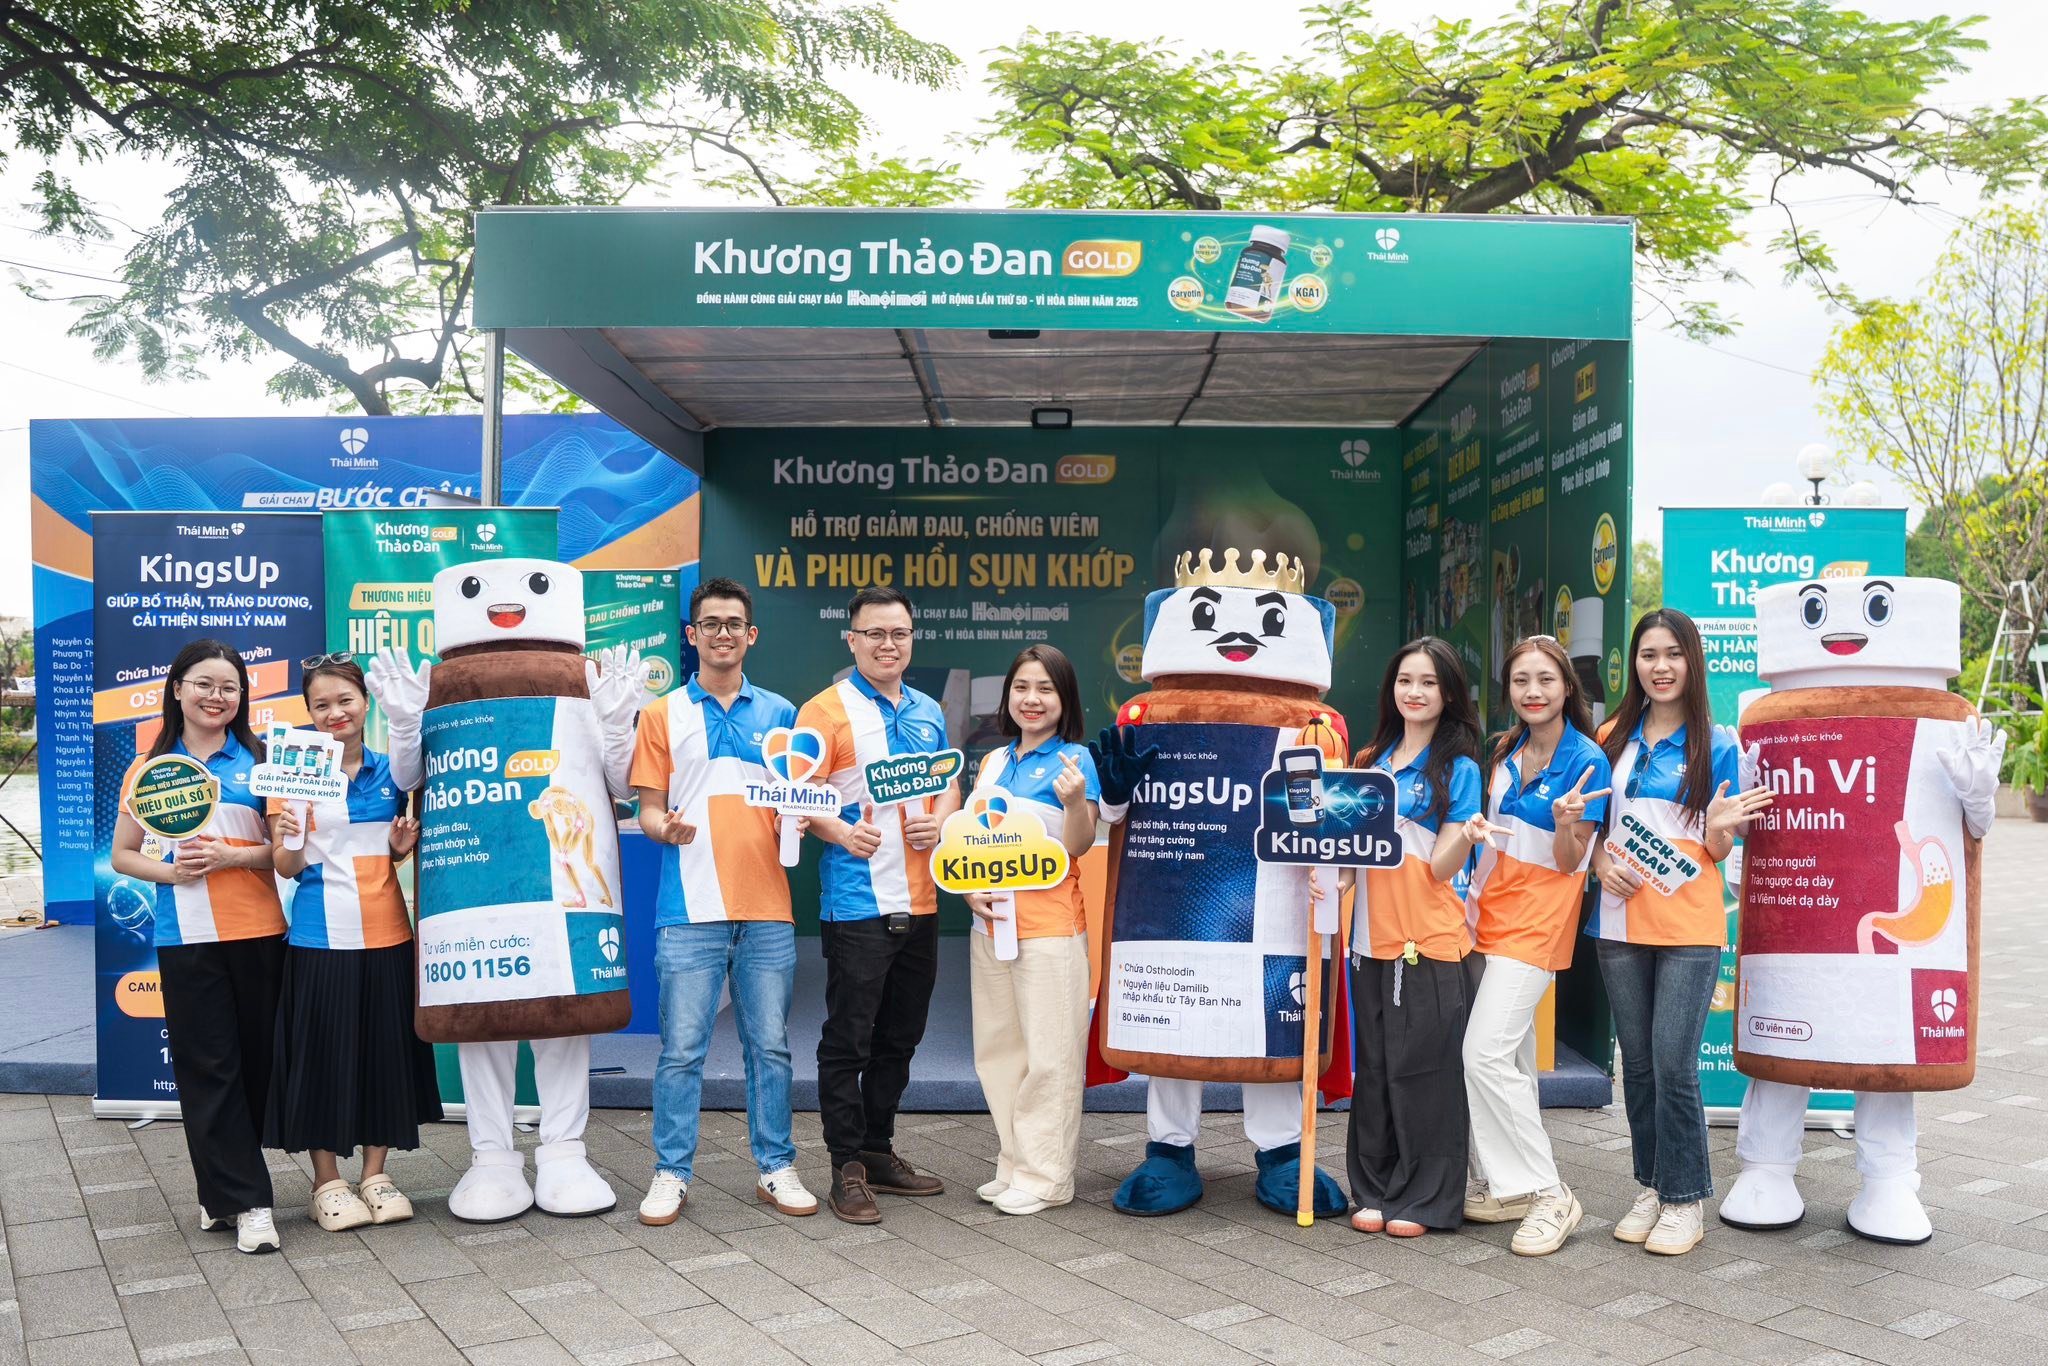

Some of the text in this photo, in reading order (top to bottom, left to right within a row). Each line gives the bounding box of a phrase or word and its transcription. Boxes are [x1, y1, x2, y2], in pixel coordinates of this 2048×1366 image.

[694, 237, 1133, 282] Khương Thảo Đan GOLD
[1367, 251, 1409, 261] Thái Minh
[724, 290, 749, 304] HÀNH
[750, 291, 776, 304] CÙNG
[777, 291, 797, 304] GIẢI
[798, 293, 822, 306] CHẠY
[824, 291, 843, 304] BÁO
[931, 292, 948, 305] MỞ
[949, 292, 974, 306] RỘNG
[1016, 295, 1028, 305] 50
[1036, 294, 1045, 306] VÌ
[1067, 294, 1090, 307] BÌNH
[1092, 295, 1114, 307] NĂM
[1115, 296, 1139, 307] 2025
[1170, 289, 1202, 300] Caryotin
[1295, 287, 1320, 298] KGA1
[330, 457, 379, 468] Thái Minh
[773, 454, 1109, 490] Khương Thảo Đan GOLD
[1330, 469, 1381, 480] Thái Minh
[259, 493, 279, 505] GIẢI
[316, 481, 392, 507] BƯỚC
[176, 524, 229, 536] Thái Minh
[375, 522, 429, 538] Khương
[790, 508, 1099, 542] HỖ TRỢ GIẢM ĐAU, CHỐNG VIÊM
[1743, 516, 1806, 528] Thái Minh
[376, 538, 440, 553] Thảo Đan
[140, 553, 280, 589] KingsUp
[754, 542, 1135, 595] VÀ PHỤC HỒI SỤN KHỚP
[1711, 548, 1814, 579] Khương
[106, 592, 313, 611] GIÚP BỔ THẬN, TRÁNG DƯƠNG,
[361, 588, 432, 605] THƯƠNG HIỆU
[132, 611, 287, 629] CẢI THIỆN SINH LÝ NAM
[589, 600, 664, 624] ĐAU CHỐNG VIÊM
[1707, 655, 1756, 673] CÔNG
[116, 668, 147, 682] Chứa
[425, 746, 554, 779] Khương GOLD
[870, 760, 954, 782] Khương GOLD
[257, 772, 342, 789] GIẢI PHÁP TOÀN DIỆN
[874, 775, 942, 799] Thảo Đan
[1827, 755, 1877, 804] Vị
[255, 784, 341, 798] CHO HỆ XƯƠNG KHỚP
[424, 779, 522, 813] Thảo Đan
[746, 784, 836, 806] Thái Minh
[1132, 773, 1253, 812] KingsUp
[137, 786, 213, 816] HIỆU QUẢ SỐ 1
[782, 804, 836, 812] PHARMACEUTICALS
[160, 810, 200, 825] VIỆT NAM
[963, 832, 1022, 846] Thái Minh
[1271, 830, 1392, 862] KingsUp
[1621, 814, 1697, 878] CHECK-IN
[1137, 849, 1155, 860] năng
[1156, 849, 1174, 859] sinh
[1175, 849, 1183, 861] lý
[1184, 852, 1205, 860] nam
[942, 853, 1057, 884] KingsUp
[1626, 856, 1652, 880] TRAO
[1764, 875, 1793, 889] ngược
[1795, 875, 1809, 889] dạ
[1812, 874, 1835, 890] dày
[435, 939, 451, 954] vấn
[454, 937, 485, 952] miễn
[489, 934, 530, 950] cước:
[425, 955, 531, 983] 1800 1156
[590, 966, 627, 980] Thái Minh
[1124, 963, 1195, 977] Chứa Ostholodin
[128, 982, 157, 993] CAM
[1123, 978, 1209, 994] Nguyên liệu Damilib
[1122, 991, 1242, 1008] nhập khẩu từ Tây Ban Nha
[1122, 1012, 1171, 1026] 80 viên nén
[1278, 1010, 1301, 1023] Thái
[1754, 1021, 1803, 1036] 80 viên nén
[1920, 1026, 1965, 1038] Thái Minh
[1700, 1042, 1733, 1057] Quét
